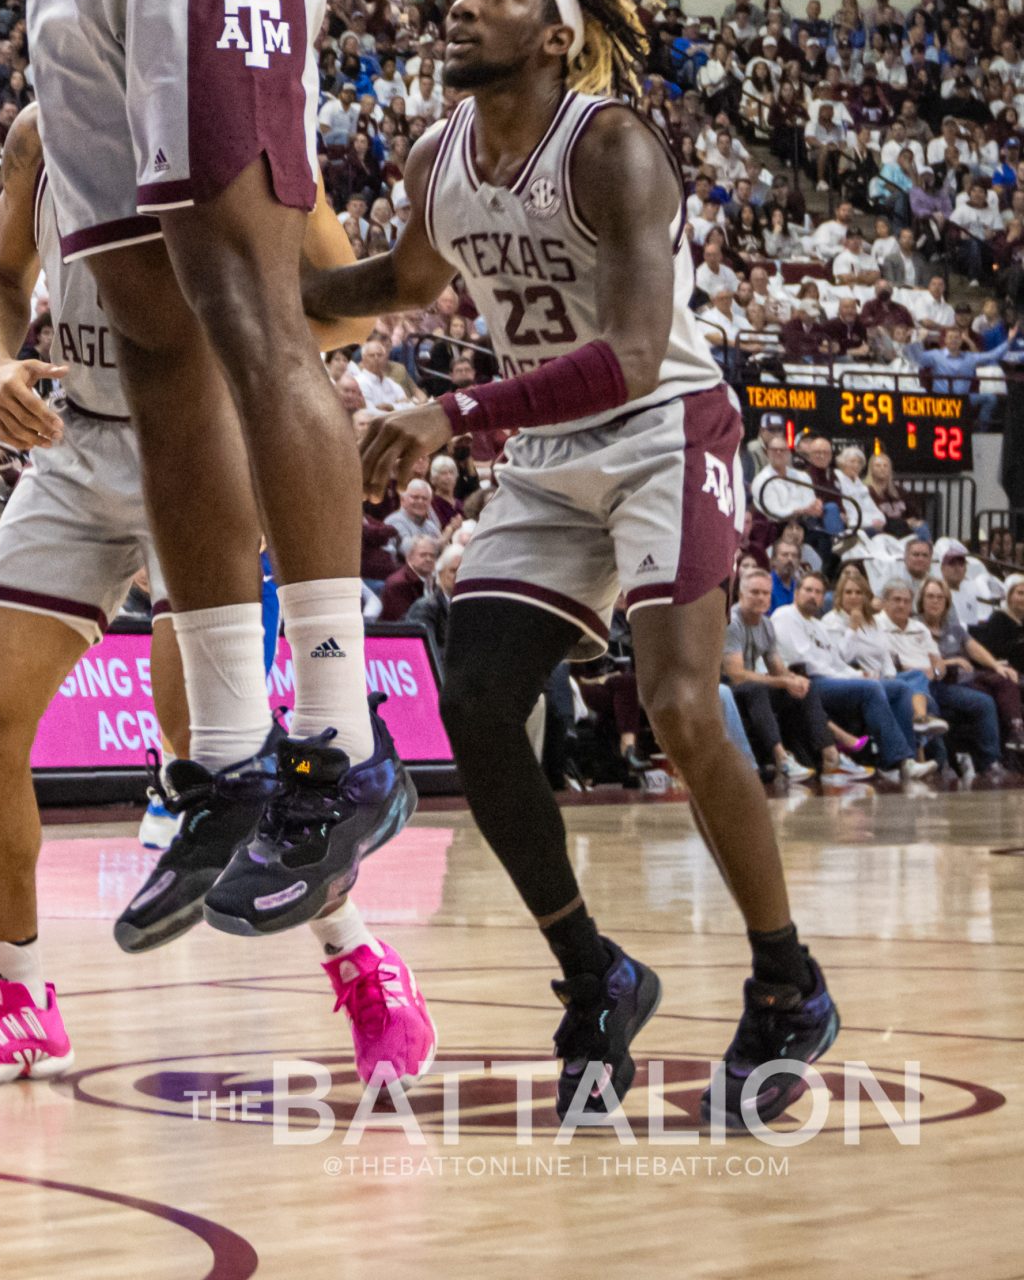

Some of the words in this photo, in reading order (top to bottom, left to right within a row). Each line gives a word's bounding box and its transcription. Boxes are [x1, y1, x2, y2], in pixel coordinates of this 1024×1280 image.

[451, 232, 577, 283] TEXAS
[493, 285, 578, 346] 23
[746, 386, 787, 409] TEXAS
[840, 392, 894, 426] 2:59
[902, 396, 962, 418] KENTUCKY
[933, 426, 964, 460] 22
